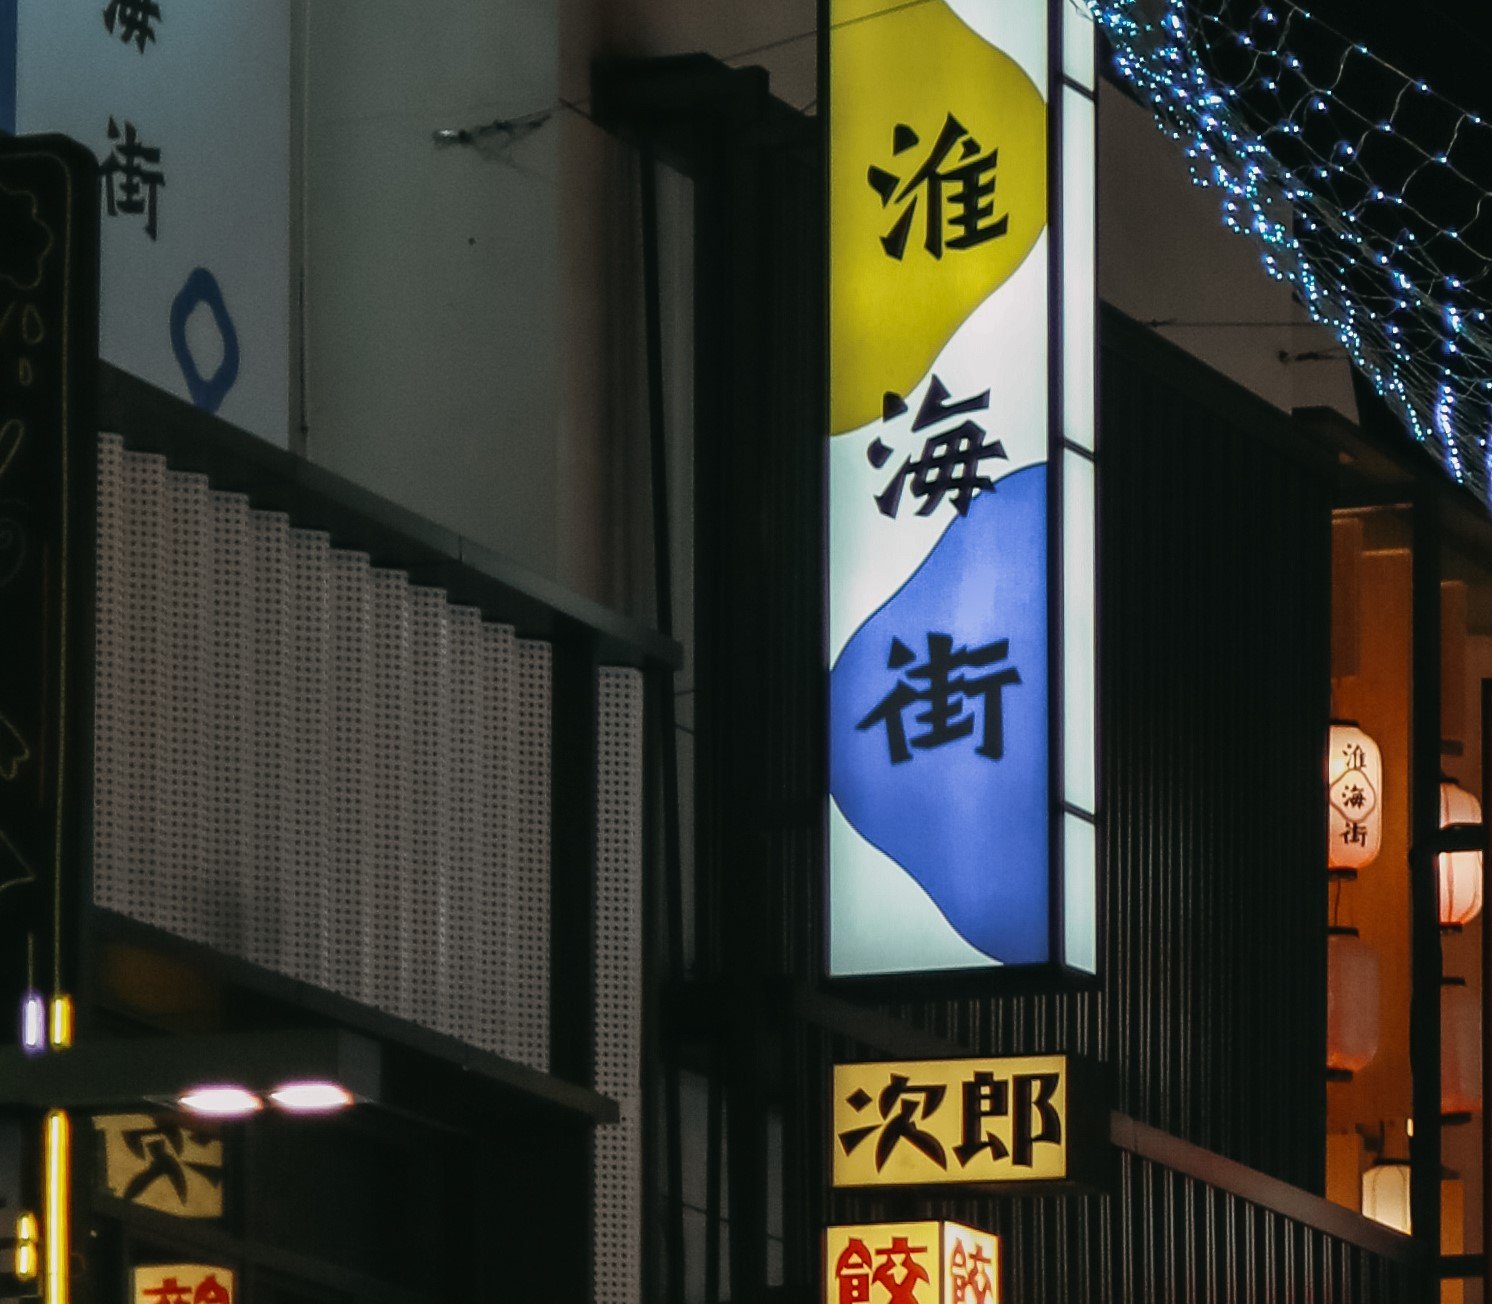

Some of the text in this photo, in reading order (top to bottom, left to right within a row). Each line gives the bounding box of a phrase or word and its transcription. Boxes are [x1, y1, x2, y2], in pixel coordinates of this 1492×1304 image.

[856, 111, 1022, 766] 淮海街
[1339, 742, 1369, 848] 淮海街
[838, 1071, 1062, 1173] 次郎
